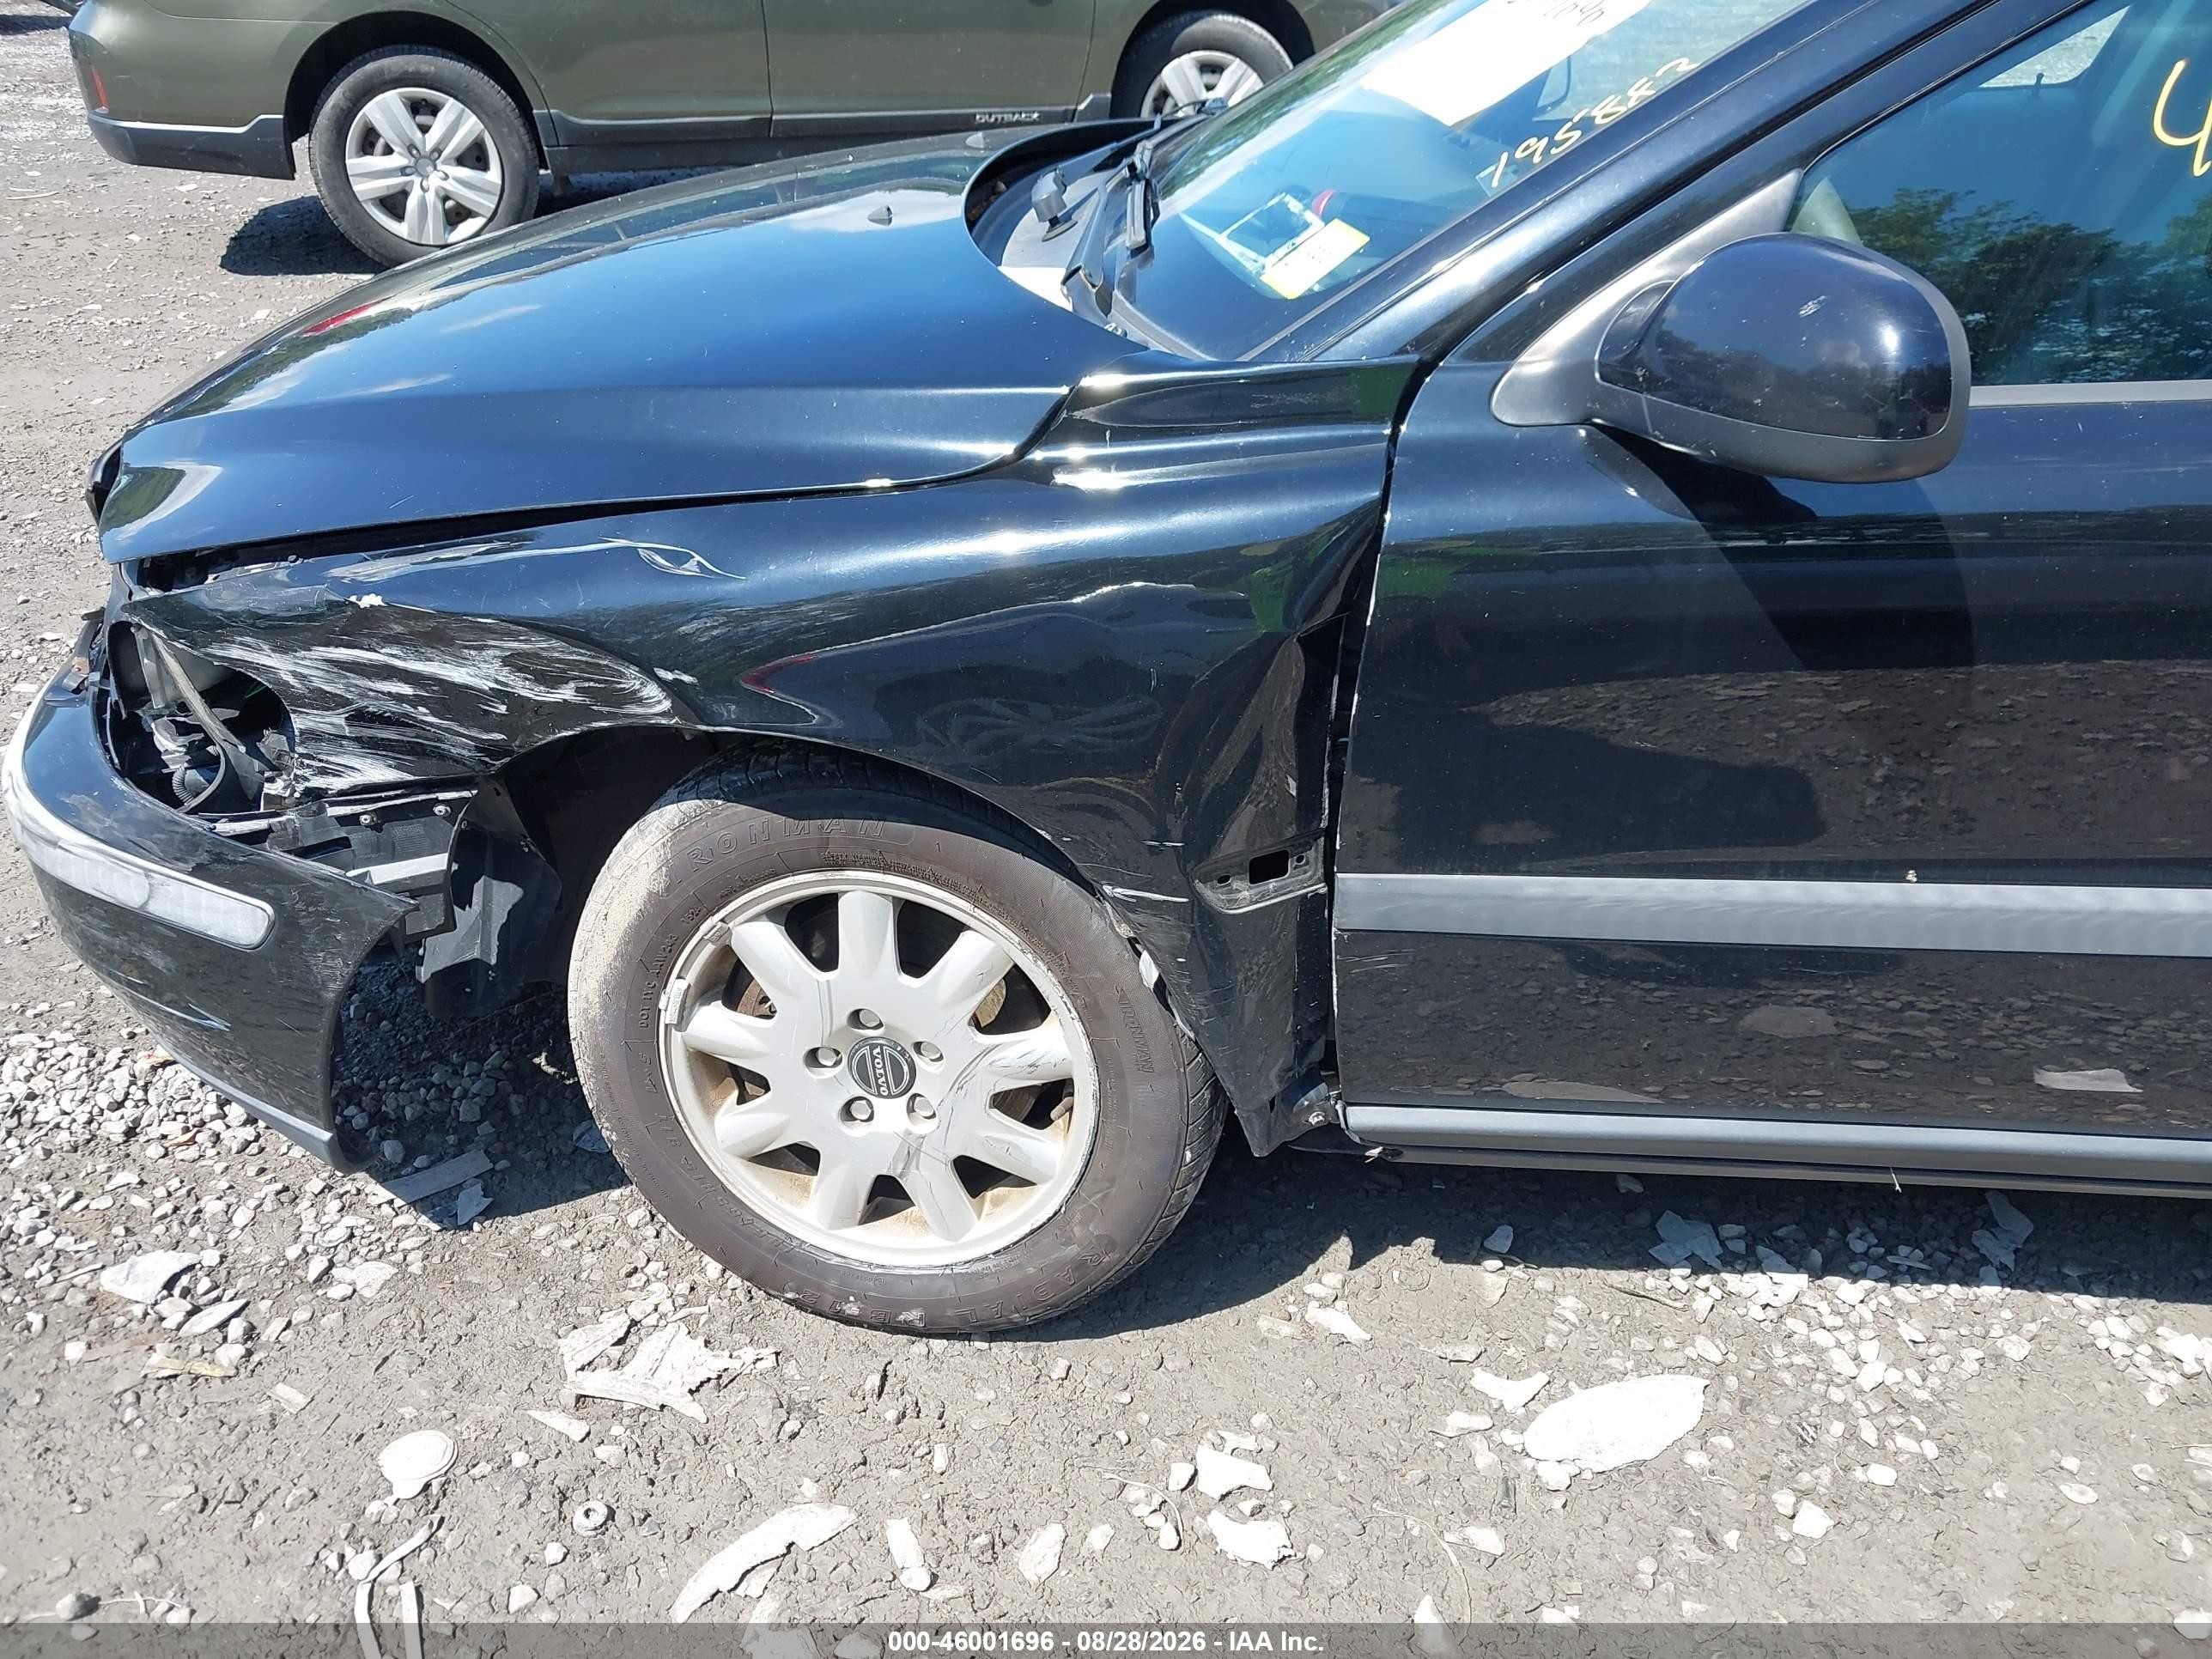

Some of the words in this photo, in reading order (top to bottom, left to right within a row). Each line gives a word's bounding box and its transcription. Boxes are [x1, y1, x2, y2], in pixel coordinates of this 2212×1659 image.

[975, 112, 1040, 123] OUTBACK
[669, 817, 886, 884] IRONMAN
[638, 1004, 650, 1029] DOT
[872, 1045, 889, 1097] VOLVO
[954, 1245, 1109, 1324] RADIAL
